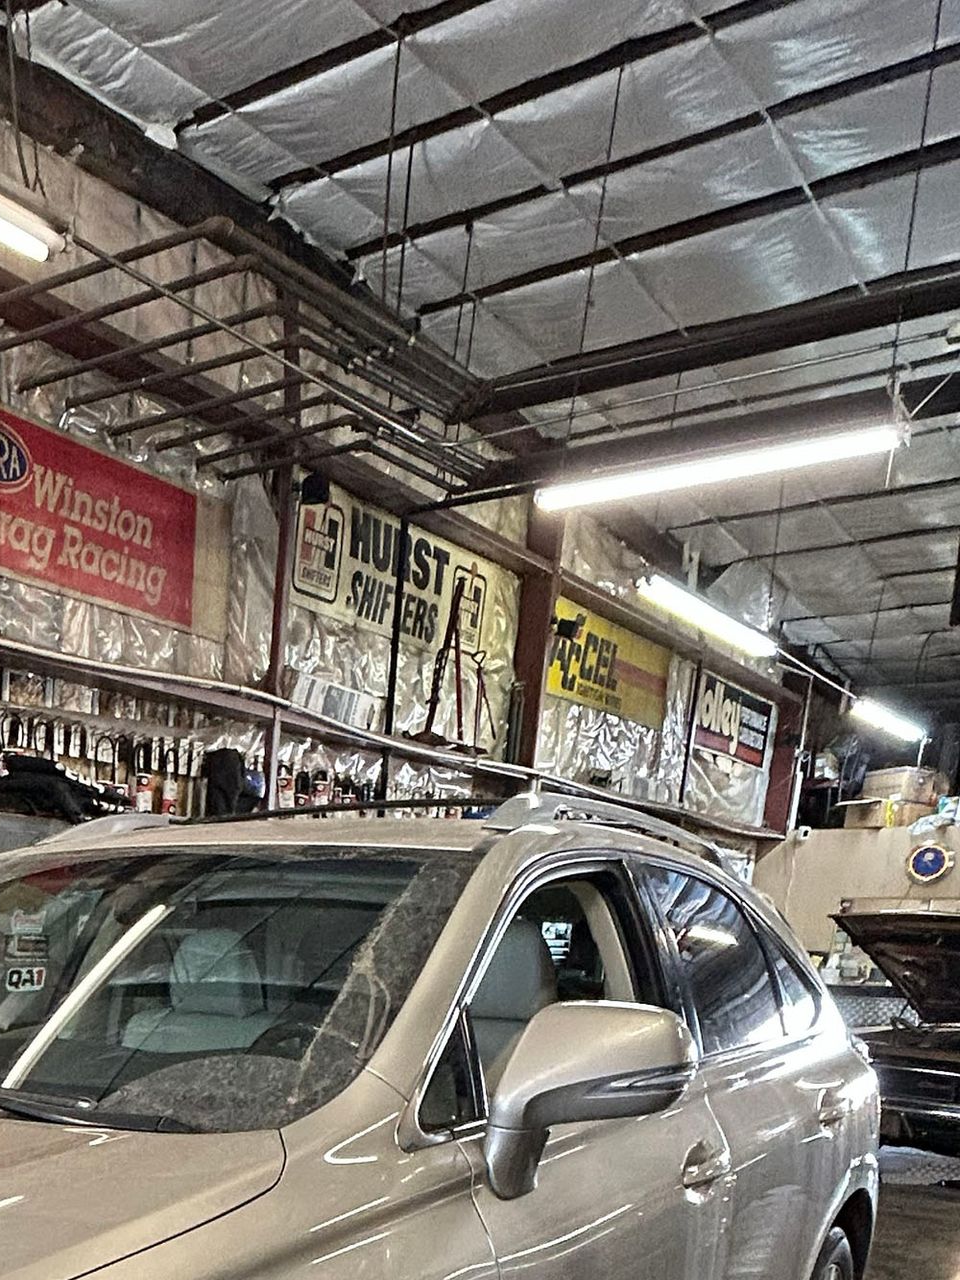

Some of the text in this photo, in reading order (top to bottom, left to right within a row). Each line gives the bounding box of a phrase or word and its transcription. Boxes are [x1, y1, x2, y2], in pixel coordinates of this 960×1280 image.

[32, 462, 154, 549] Winston
[57, 522, 167, 606] Racing
[346, 570, 439, 644] SHIFERS
[7, 969, 45, 990] QA1
